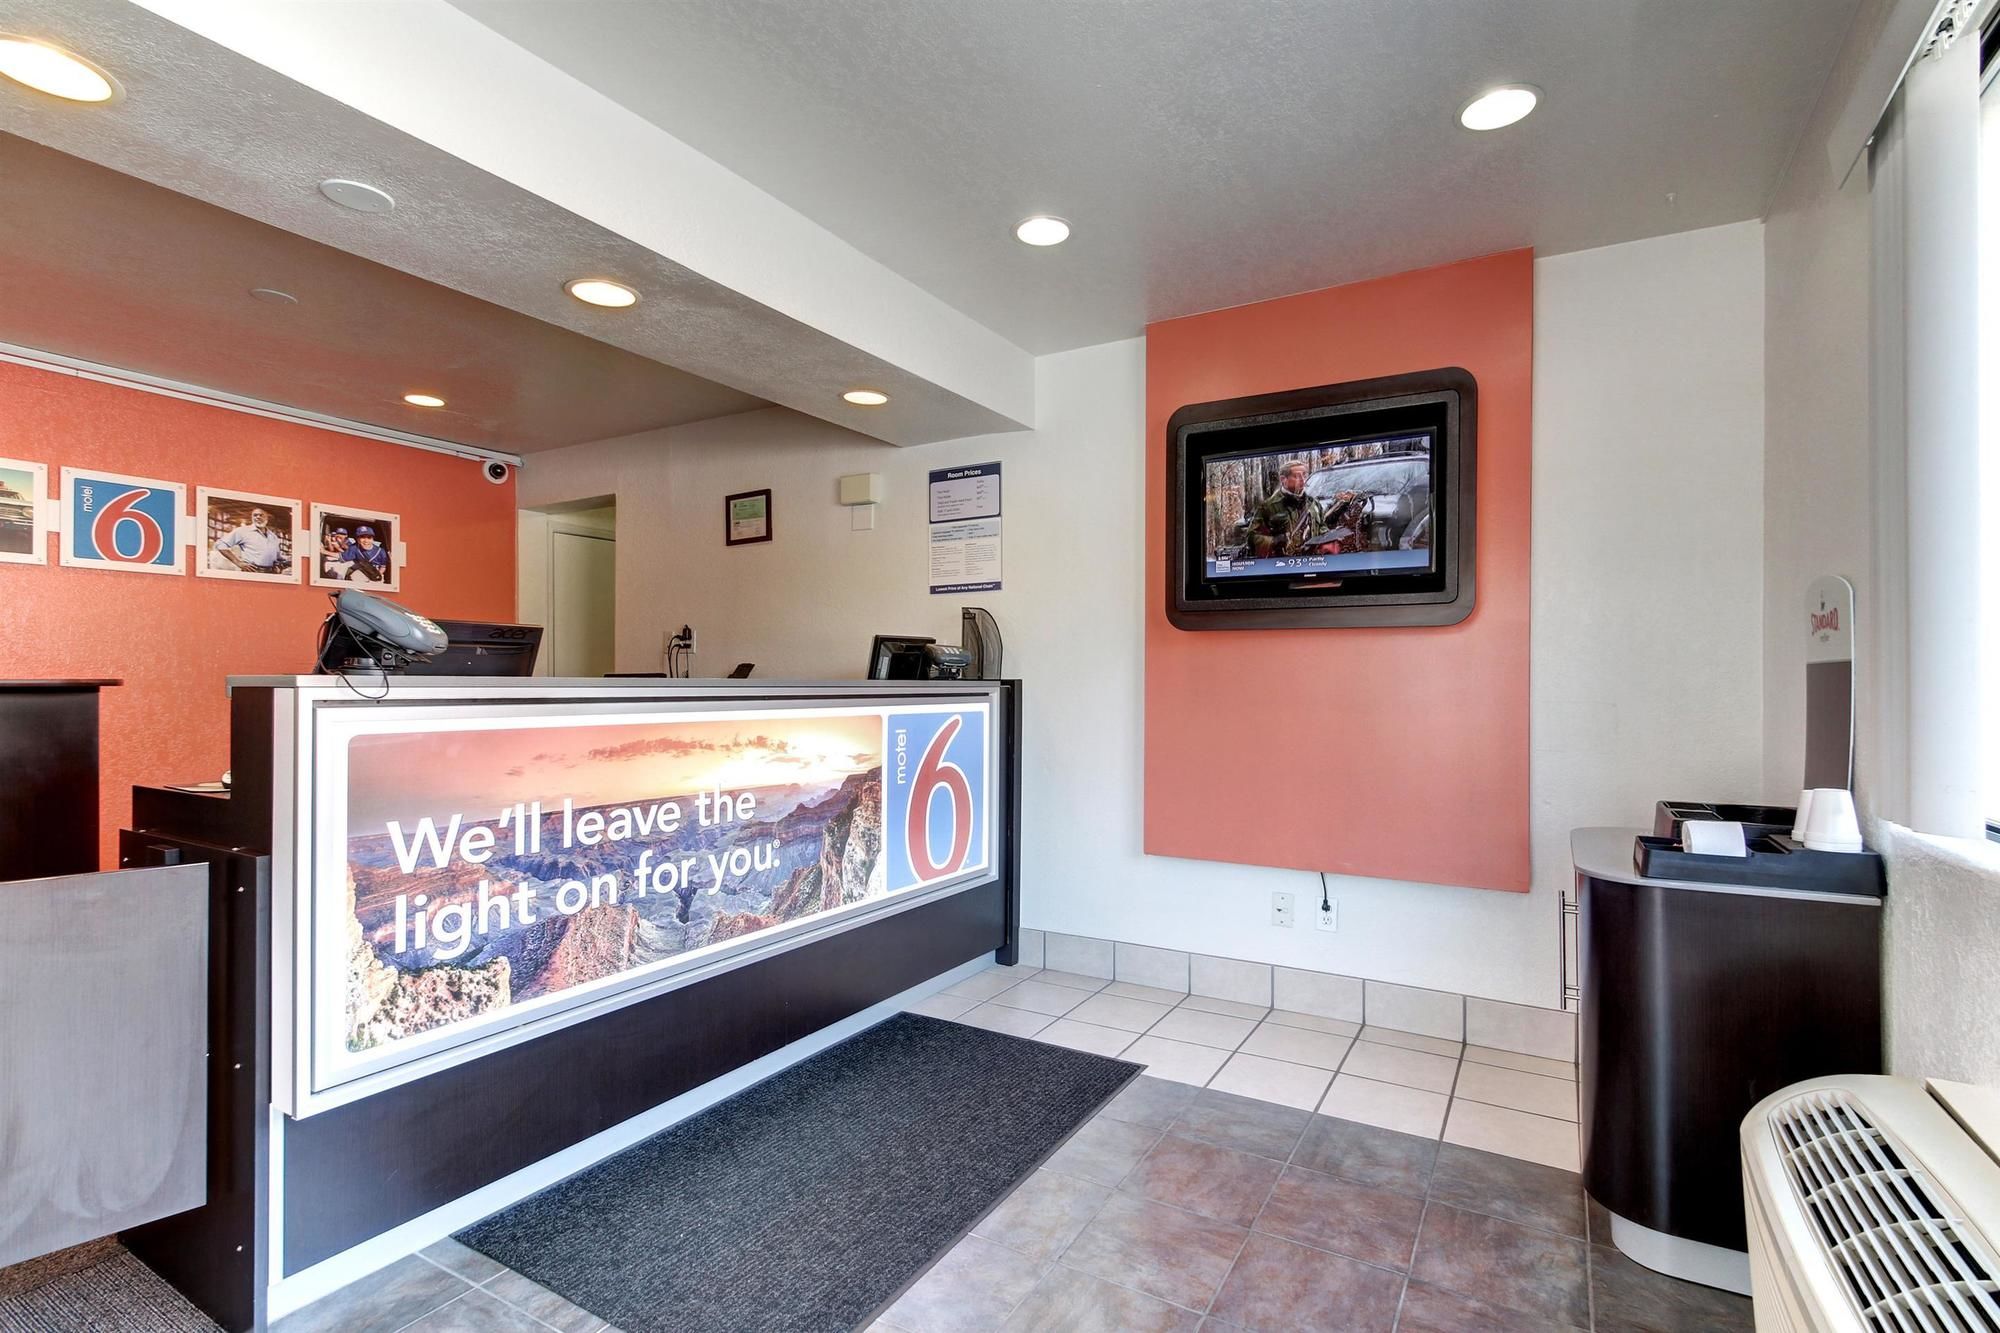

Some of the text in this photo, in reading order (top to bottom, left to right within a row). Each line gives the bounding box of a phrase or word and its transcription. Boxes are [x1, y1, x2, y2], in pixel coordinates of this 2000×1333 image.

[947, 469, 982, 479] Room Prices
[81, 485, 163, 565] motel 6
[488, 628, 529, 640] acer
[563, 798, 684, 849] leave
[694, 790, 757, 827] the
[895, 714, 974, 883] motel 6
[394, 879, 536, 960] light
[556, 877, 619, 916] on
[634, 848, 699, 898] for
